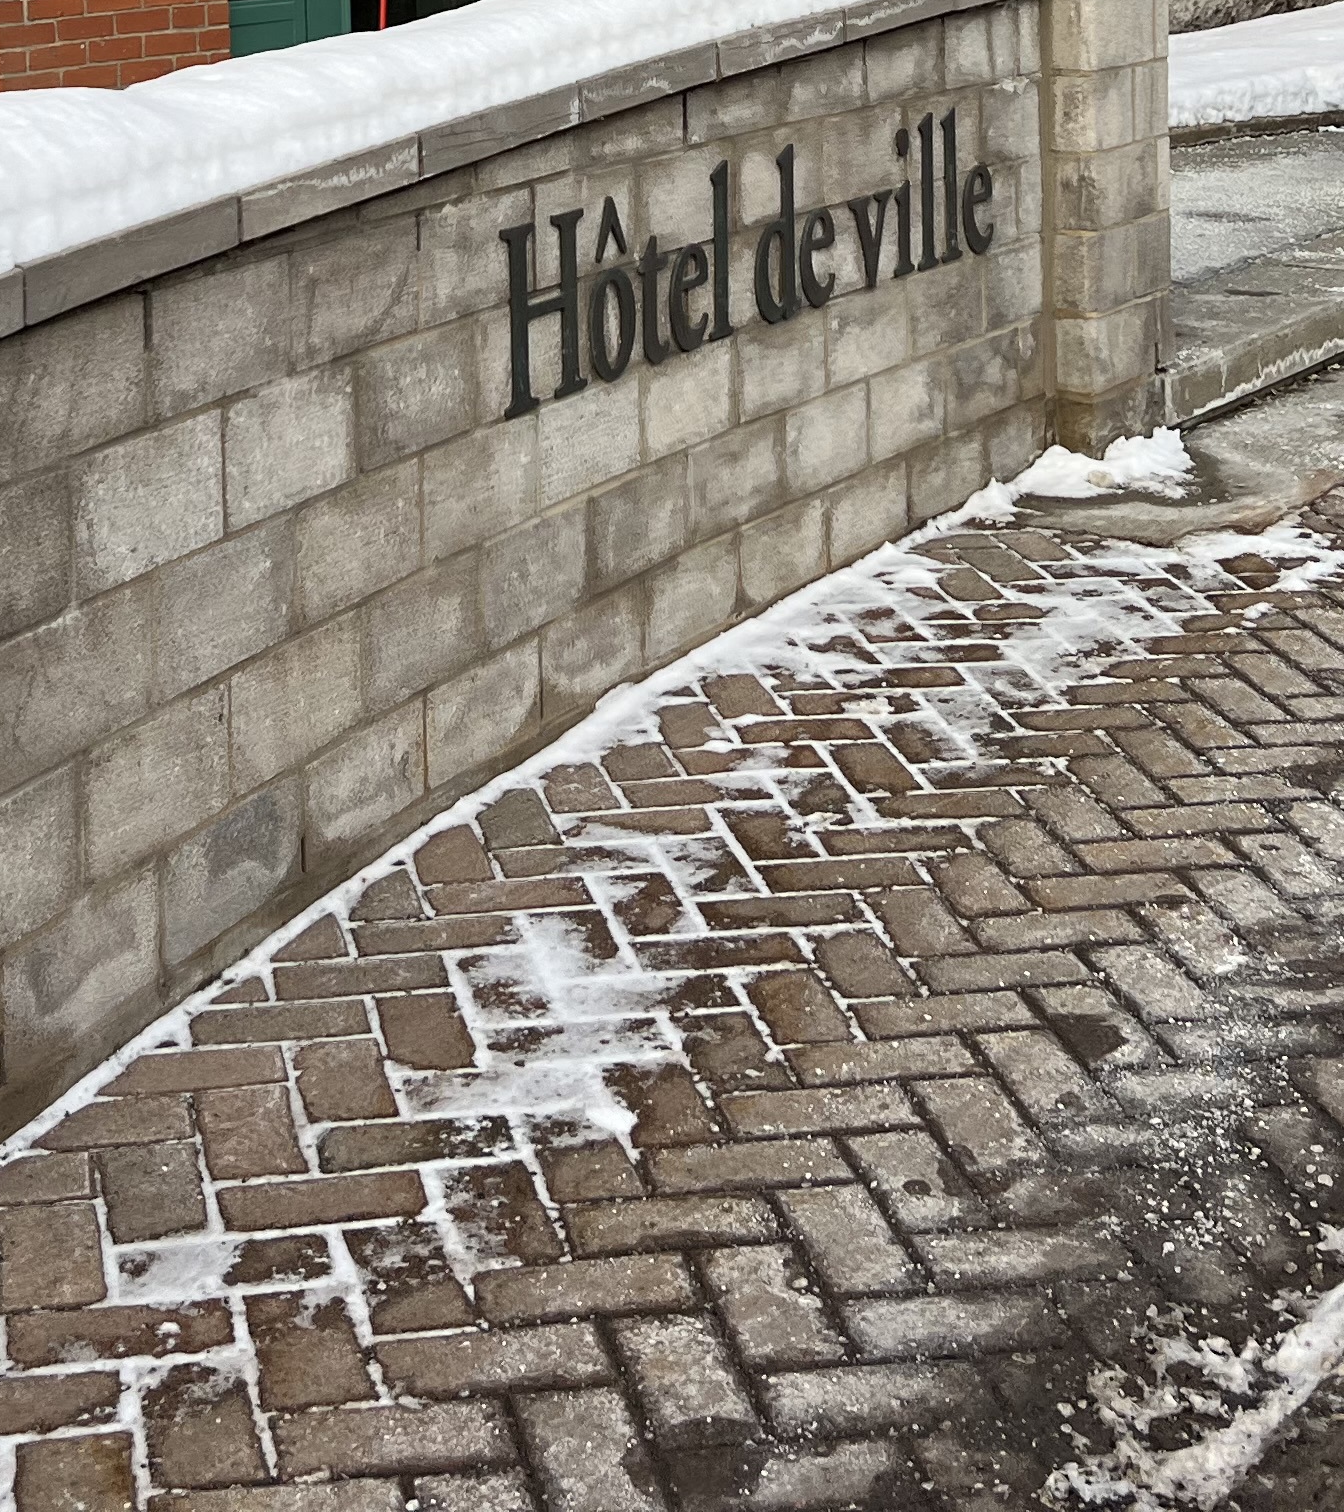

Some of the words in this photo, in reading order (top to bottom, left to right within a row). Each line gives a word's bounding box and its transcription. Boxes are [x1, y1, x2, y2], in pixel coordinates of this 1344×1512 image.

[499, 159, 735, 419] Hôtel
[754, 143, 837, 325] de
[847, 107, 994, 289] ville
